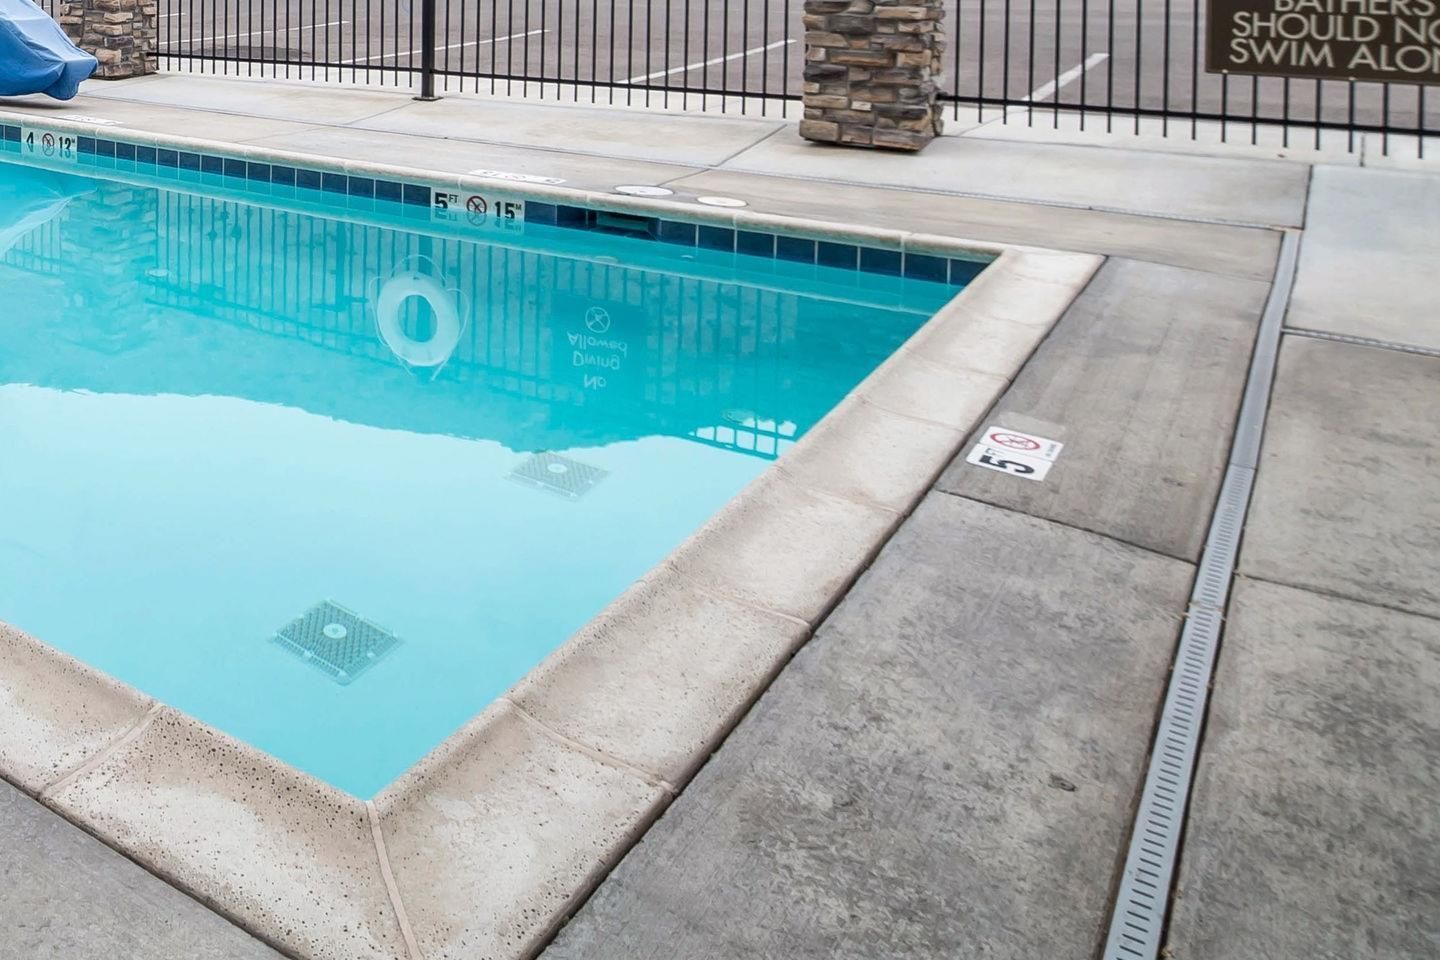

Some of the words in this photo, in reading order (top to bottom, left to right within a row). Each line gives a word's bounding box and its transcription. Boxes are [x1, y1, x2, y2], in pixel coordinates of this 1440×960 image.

[1232, 11, 1380, 42] SHOULD
[1230, 38, 1334, 68] SWIM
[1347, 43, 1440, 74] ALO
[435, 192, 448, 209] 5
[449, 194, 459, 203] FT
[979, 455, 1035, 474] 5
